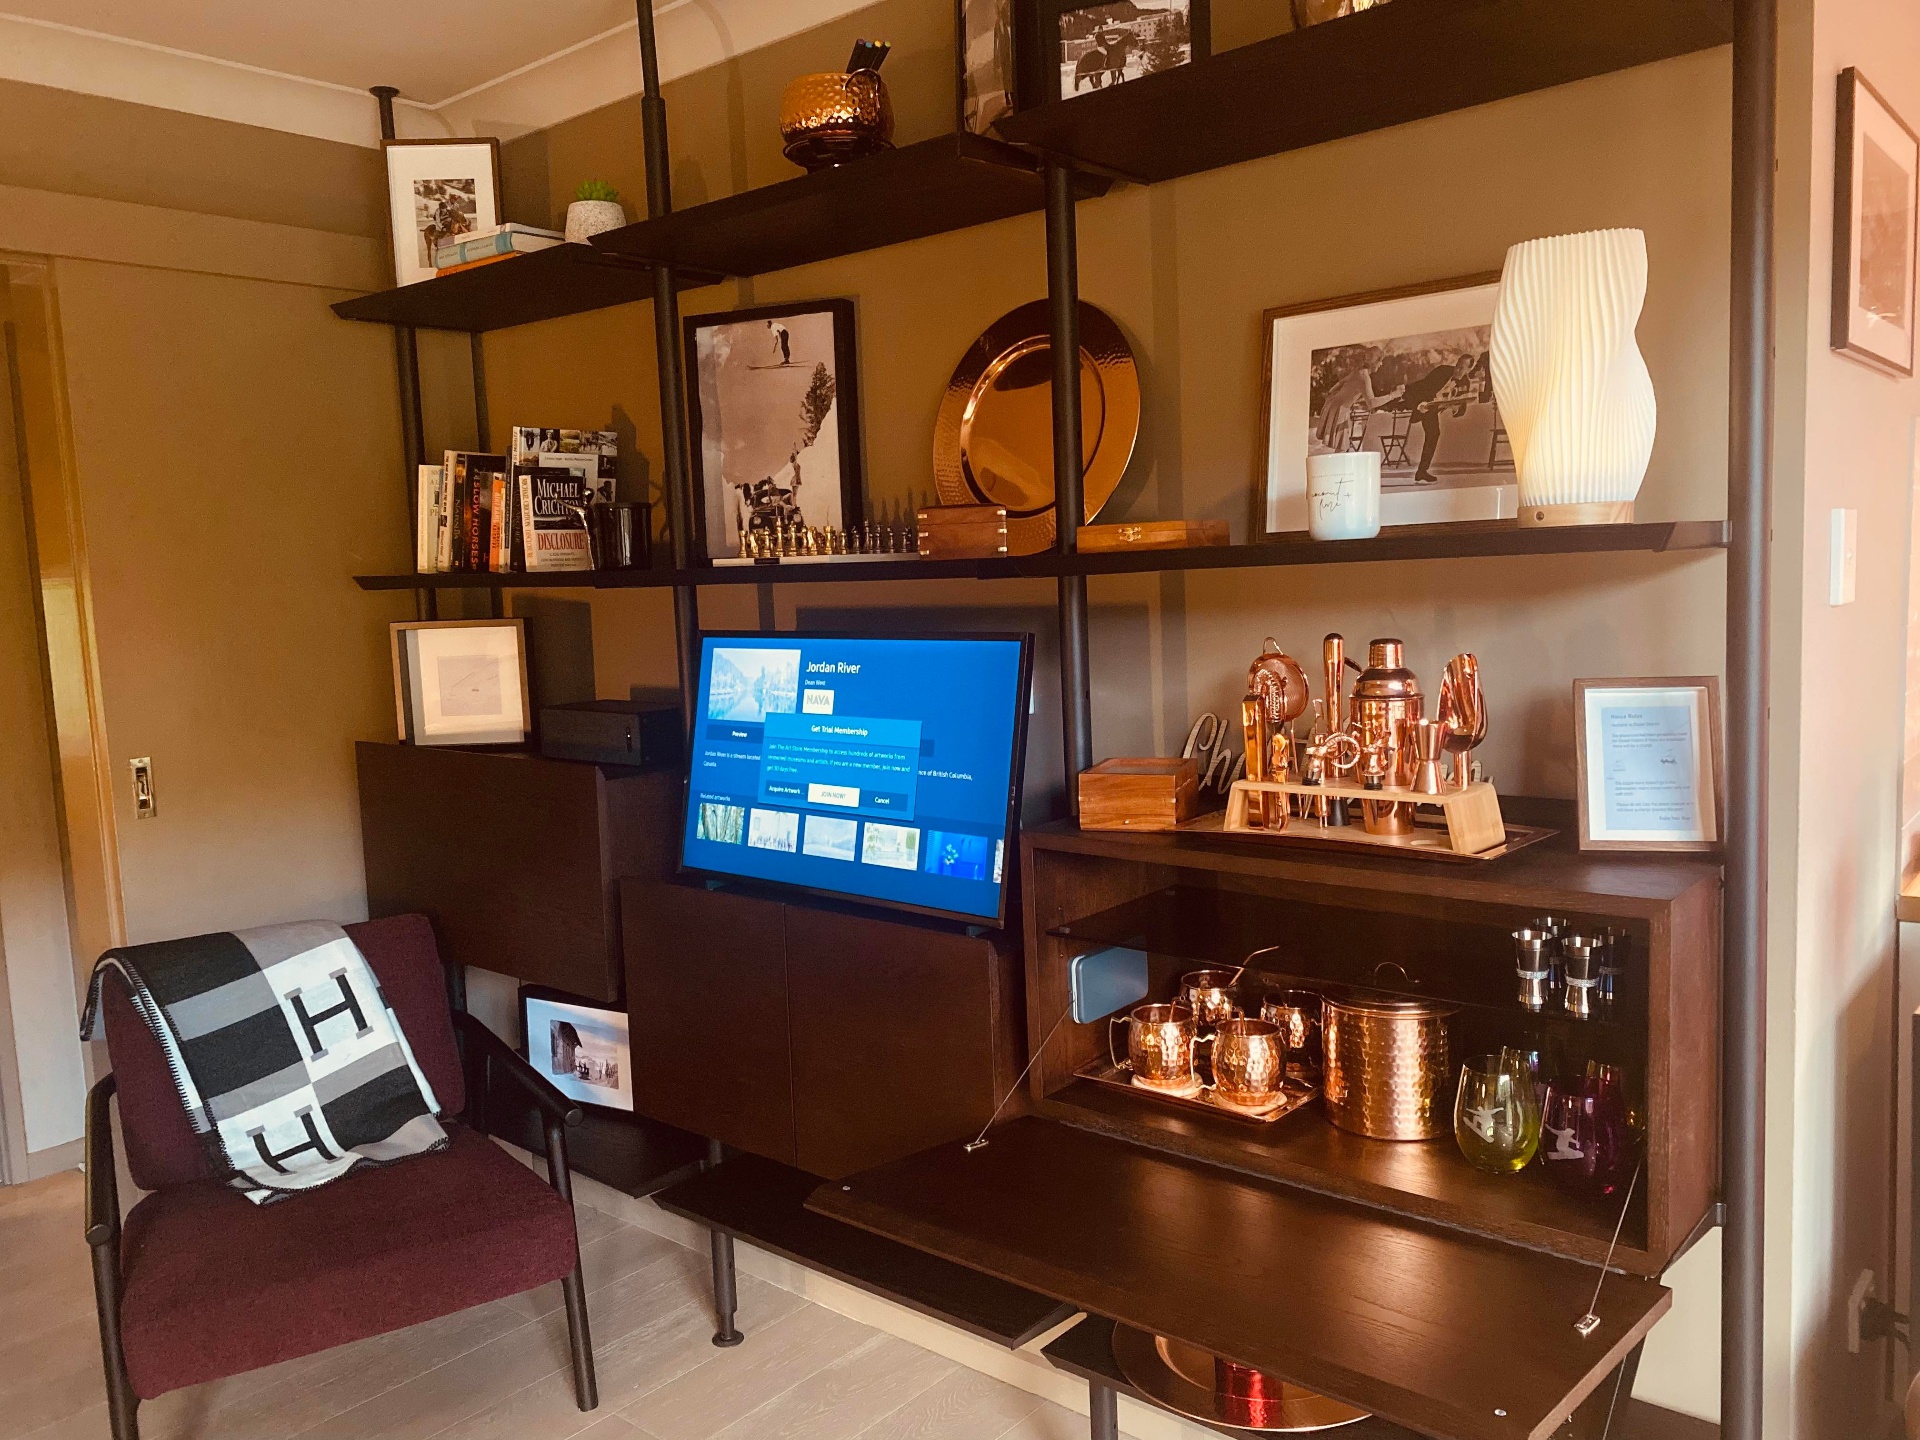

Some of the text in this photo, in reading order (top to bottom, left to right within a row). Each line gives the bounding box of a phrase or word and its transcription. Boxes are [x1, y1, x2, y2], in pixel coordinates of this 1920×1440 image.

[537, 478, 580, 498] MICHAEL
[470, 482, 481, 564] SLOW HORSES
[537, 532, 584, 550] DISCLOSURE
[806, 662, 861, 674] Jordan River
[807, 695, 830, 705] NAVA
[822, 725, 833, 734] Trial
[834, 726, 868, 737] Membership
[804, 746, 828, 754] Membership
[949, 772, 972, 781] Columbia,
[769, 785, 783, 793] Acquire
